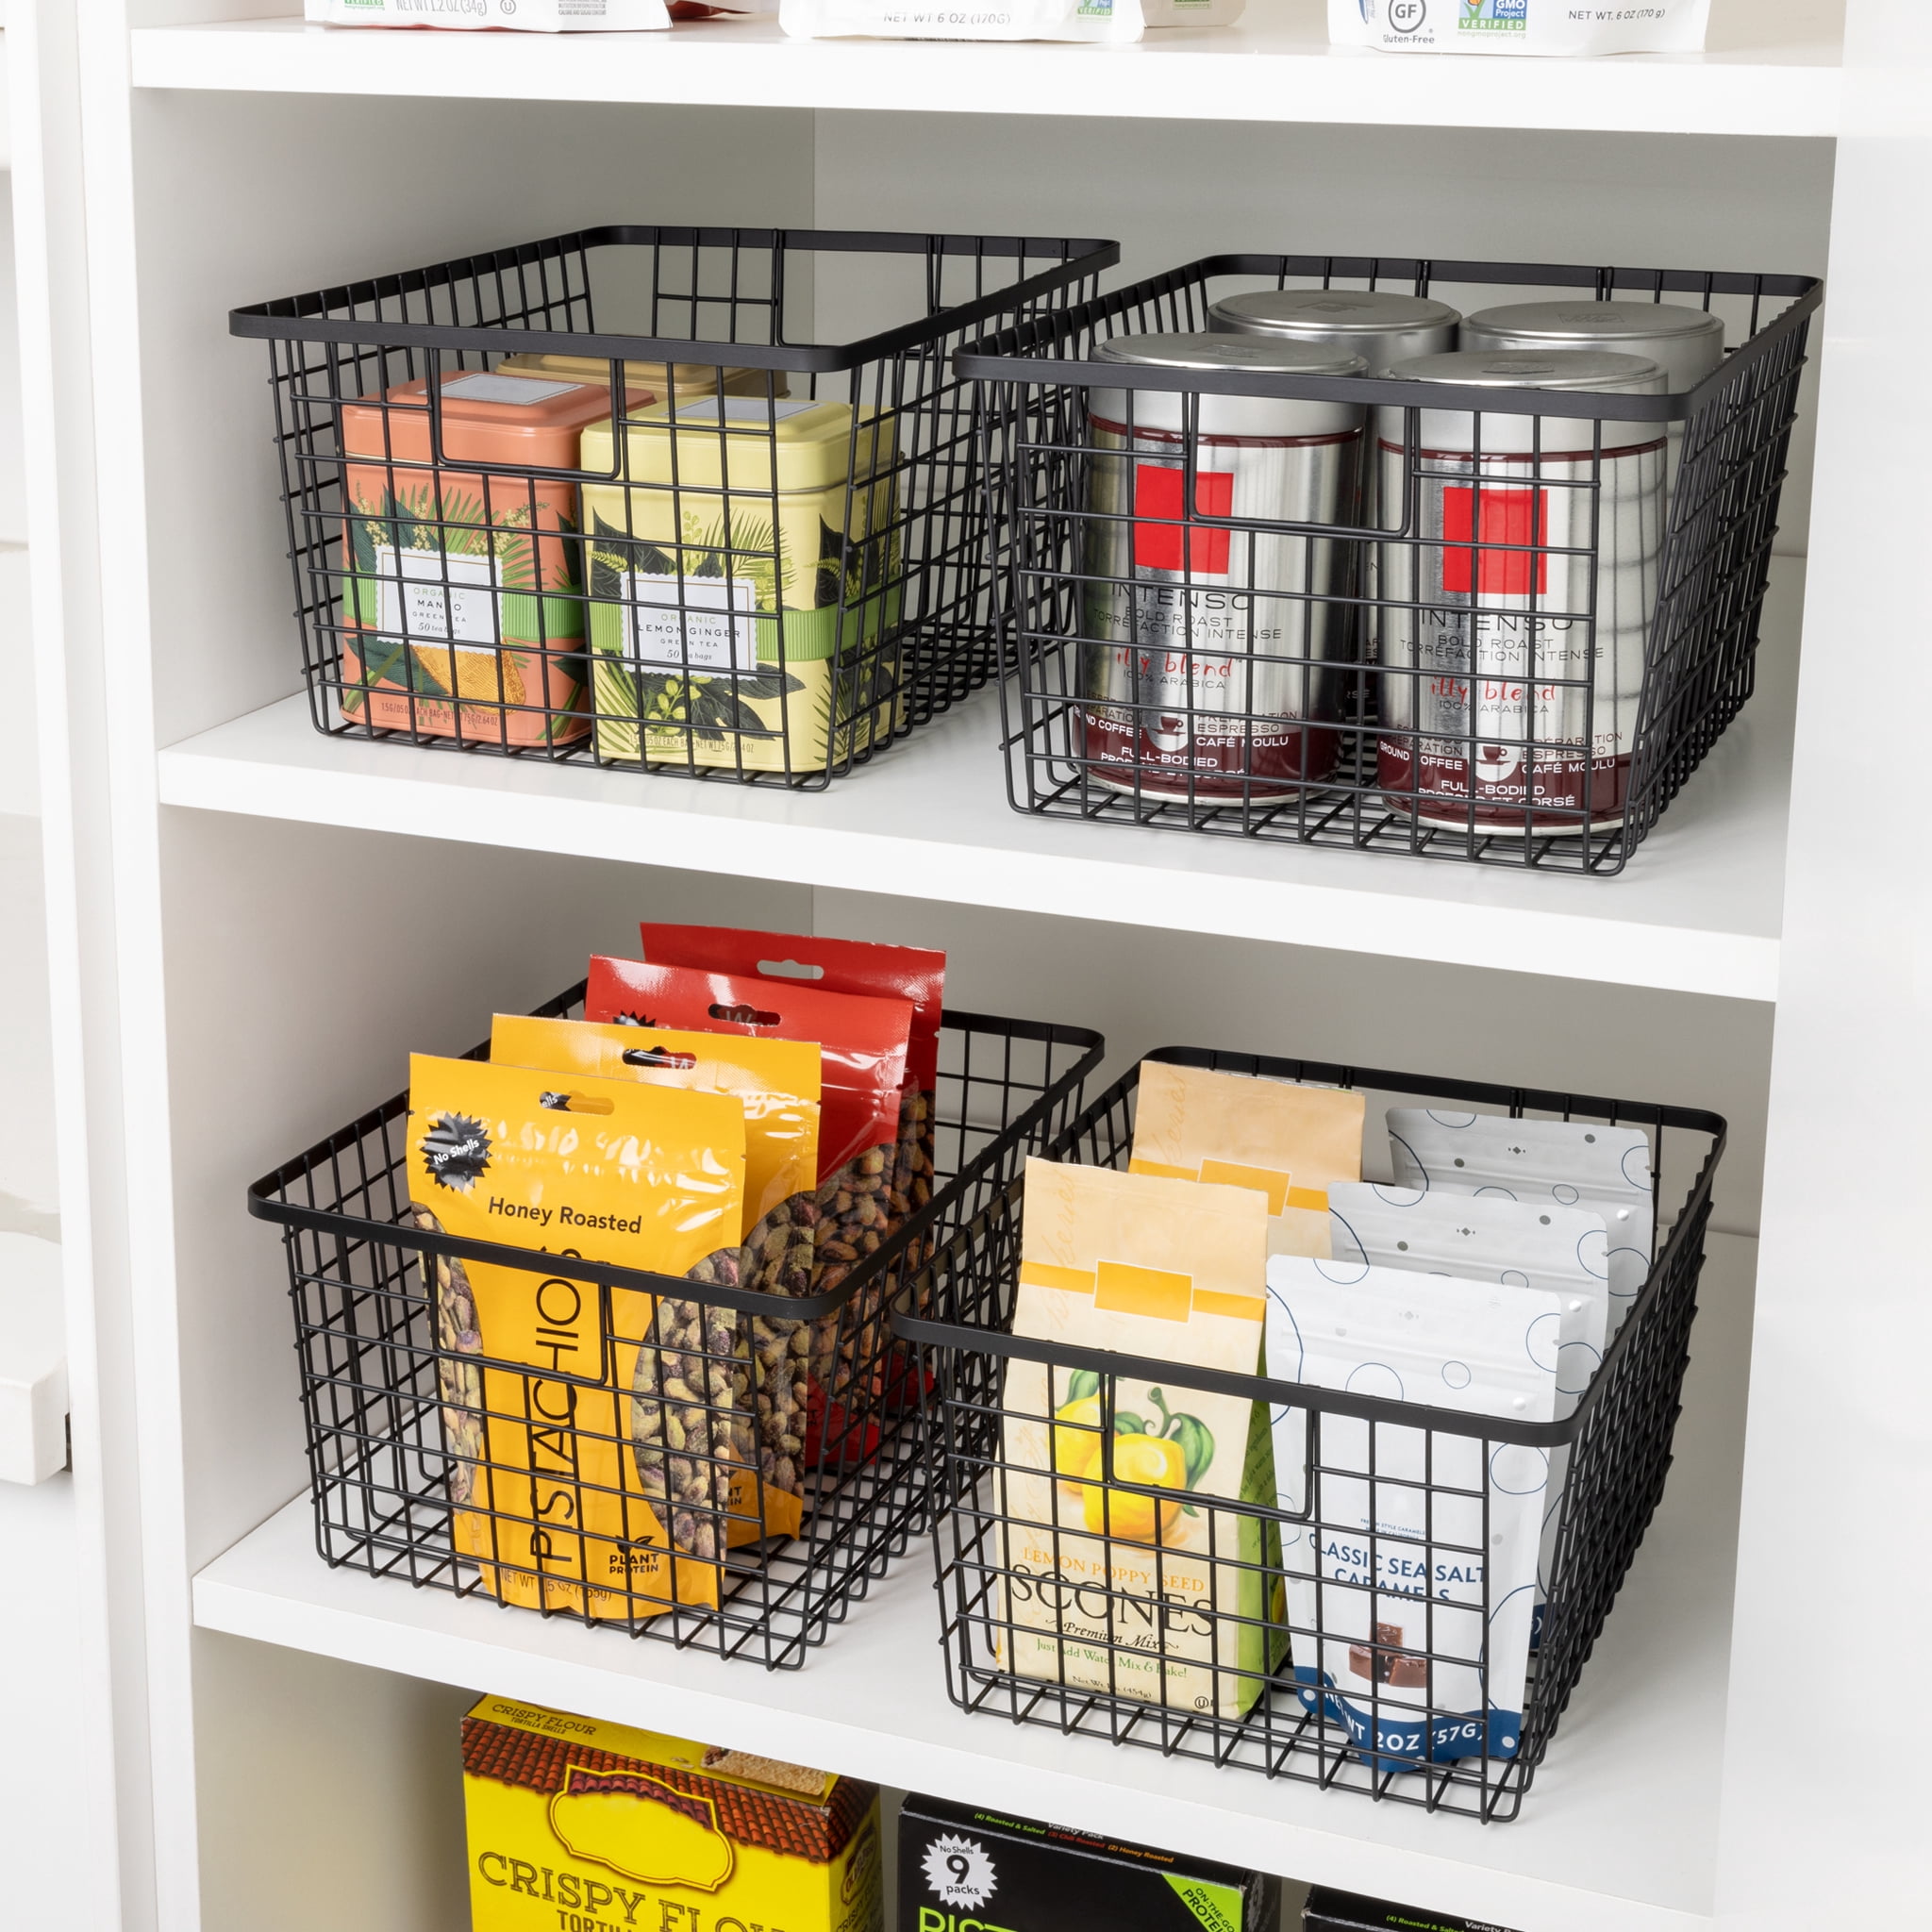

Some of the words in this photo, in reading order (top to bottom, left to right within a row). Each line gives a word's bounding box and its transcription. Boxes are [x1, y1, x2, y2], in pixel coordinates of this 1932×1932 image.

[1496, 0, 1525, 9] GMO
[1395, 4, 1417, 19] GF
[1495, 8, 1524, 19] Project
[1569, 10, 1591, 20] NET
[1595, 11, 1613, 20] WT.
[1616, 11, 1623, 20] 6
[1624, 10, 1636, 19] OZ
[883, 13, 907, 22] NET
[938, 13, 945, 23] 6
[950, 13, 967, 24] OZ
[1462, 20, 1524, 30] VERIFIED
[413, 587, 466, 600] ORGAIC
[418, 600, 461, 611] MANO
[661, 613, 717, 625] ORANIC
[418, 623, 430, 632] 50
[638, 625, 682, 634] LEMON
[690, 627, 741, 638] GINGER
[1490, 639, 1554, 650] ROAST
[667, 650, 680, 659] 50
[1536, 647, 1604, 662] NTENSE
[1117, 647, 1150, 675] ily
[1165, 652, 1234, 677] blend
[1160, 675, 1225, 690] ARABICA
[1197, 723, 1279, 734] ESPRESSO
[1196, 736, 1236, 747] CAFÉ
[1418, 756, 1463, 771] OFFEE
[1522, 762, 1562, 774] CAFÉ
[1441, 780, 1545, 795] FUL-BODID
[433, 1153, 449, 1165] No
[450, 1139, 480, 1158] Shells
[489, 1196, 554, 1226] Honey
[559, 1206, 642, 1235] Roasted
[529, 1246, 581, 1563] PSTACHIO
[609, 1553, 659, 1565] PLANT
[609, 1564, 658, 1574] PRTEIN
[1023, 1548, 1086, 1572] LEMON
[1091, 1562, 1151, 1585] POPPY
[1162, 1574, 1206, 1592] SEED
[1389, 1557, 1428, 1579] SEA
[1435, 1565, 1484, 1583] SALT
[519, 1573, 535, 1589] WT
[1012, 1564, 1215, 1637] SCONES
[1064, 1622, 1124, 1643] Premium
[1126, 1634, 1159, 1649] Mix
[1037, 1639, 1056, 1652] Just
[1084, 1649, 1110, 1664] Wate
[1119, 1657, 1141, 1671] Mix
[1143, 1664, 1154, 1673] &
[491, 1704, 547, 1725] CRISPY
[546, 1715, 597, 1736] FLOUR
[985, 1815, 1015, 1828] Roasted
[1022, 1824, 1046, 1835] Salted
[1048, 1823, 1080, 1836] Variety
[940, 1845, 952, 1854] No
[952, 1846, 974, 1855] Shells
[1119, 1846, 1143, 1857] Honey
[1143, 1852, 1174, 1863] Roasted
[946, 1855, 970, 1885] 9
[478, 1851, 646, 1925] CRISPY
[946, 1884, 980, 1895] packs
[1398, 1918, 1430, 1929] Roasted
